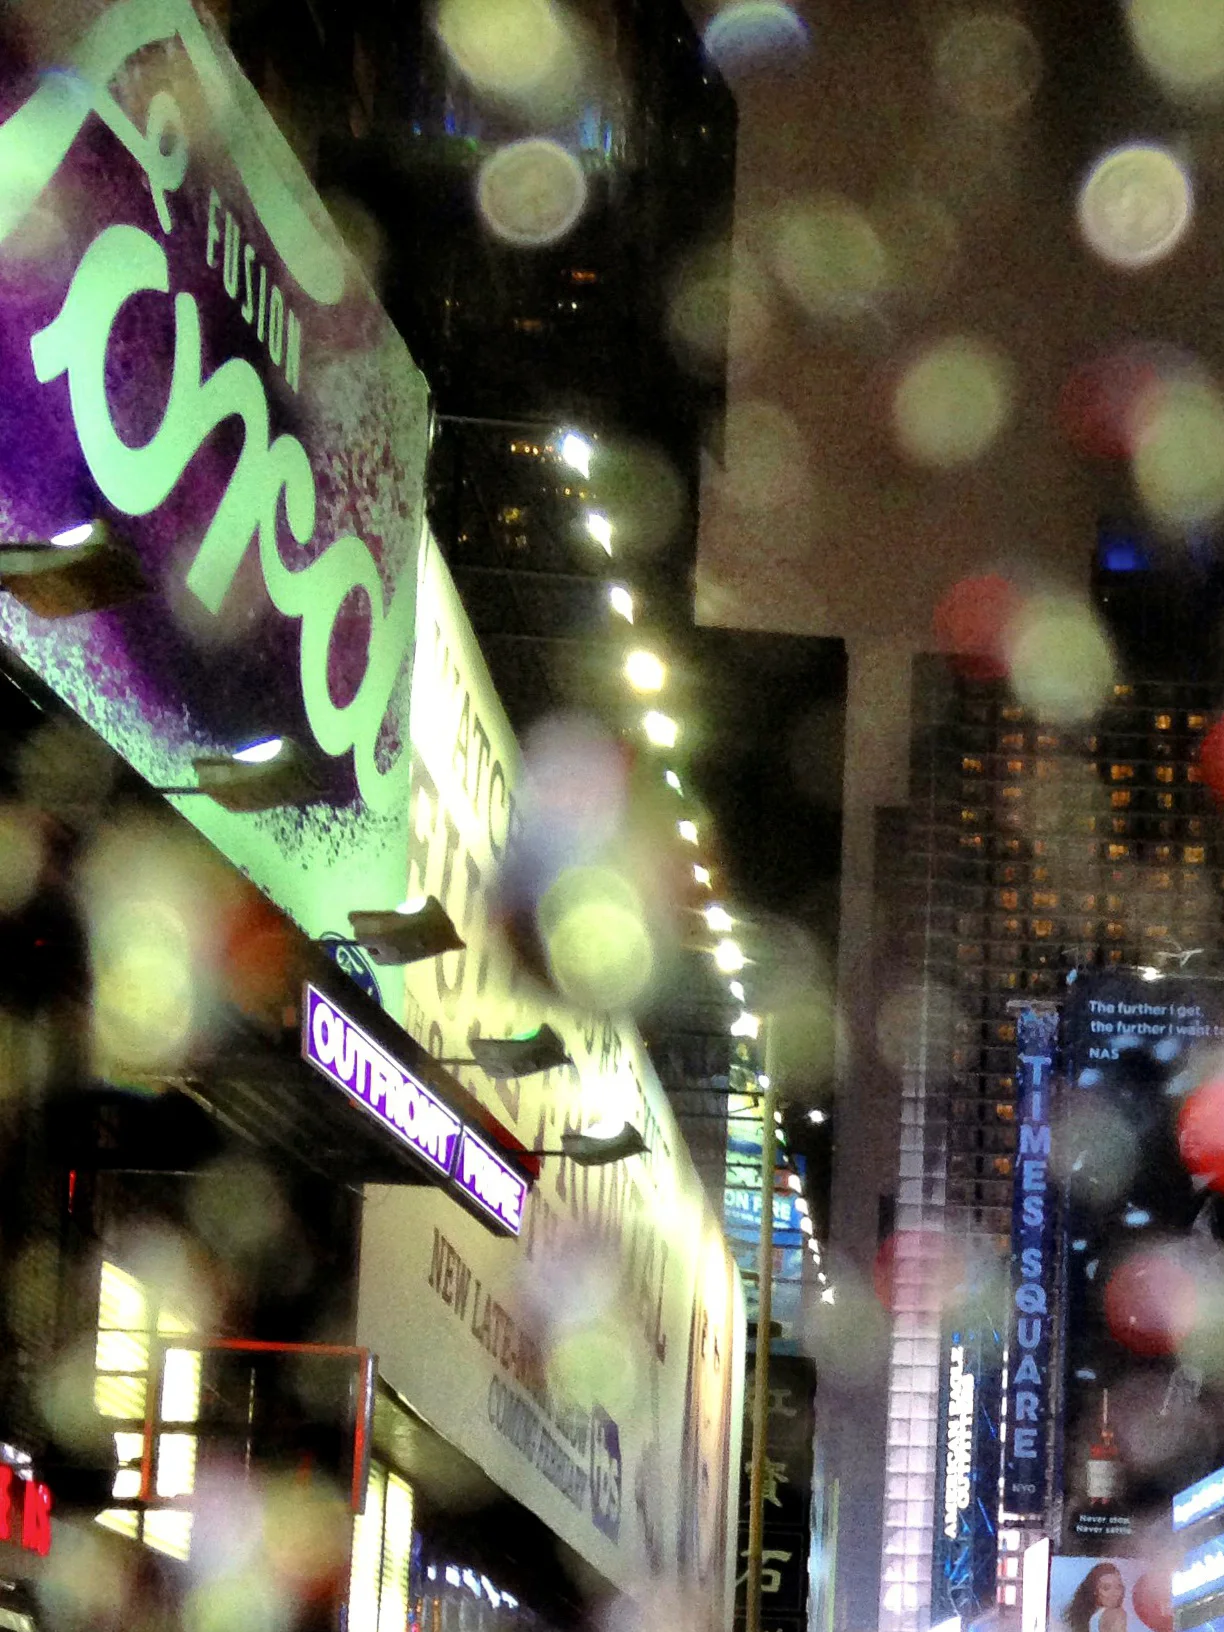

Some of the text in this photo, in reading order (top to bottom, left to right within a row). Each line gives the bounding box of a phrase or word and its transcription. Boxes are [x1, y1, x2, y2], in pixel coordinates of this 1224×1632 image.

[205, 186, 301, 393] FUSION
[1089, 1000, 1114, 1014] The
[1117, 1001, 1167, 1015] further
[1089, 1048, 1120, 1060] NAS
[1091, 1021, 1113, 1033] the
[1116, 1021, 1166, 1034] further
[313, 1002, 460, 1164] OUTFRONT
[429, 1226, 471, 1321] NEW
[1013, 1054, 1051, 1458] TIMES SQUARE
